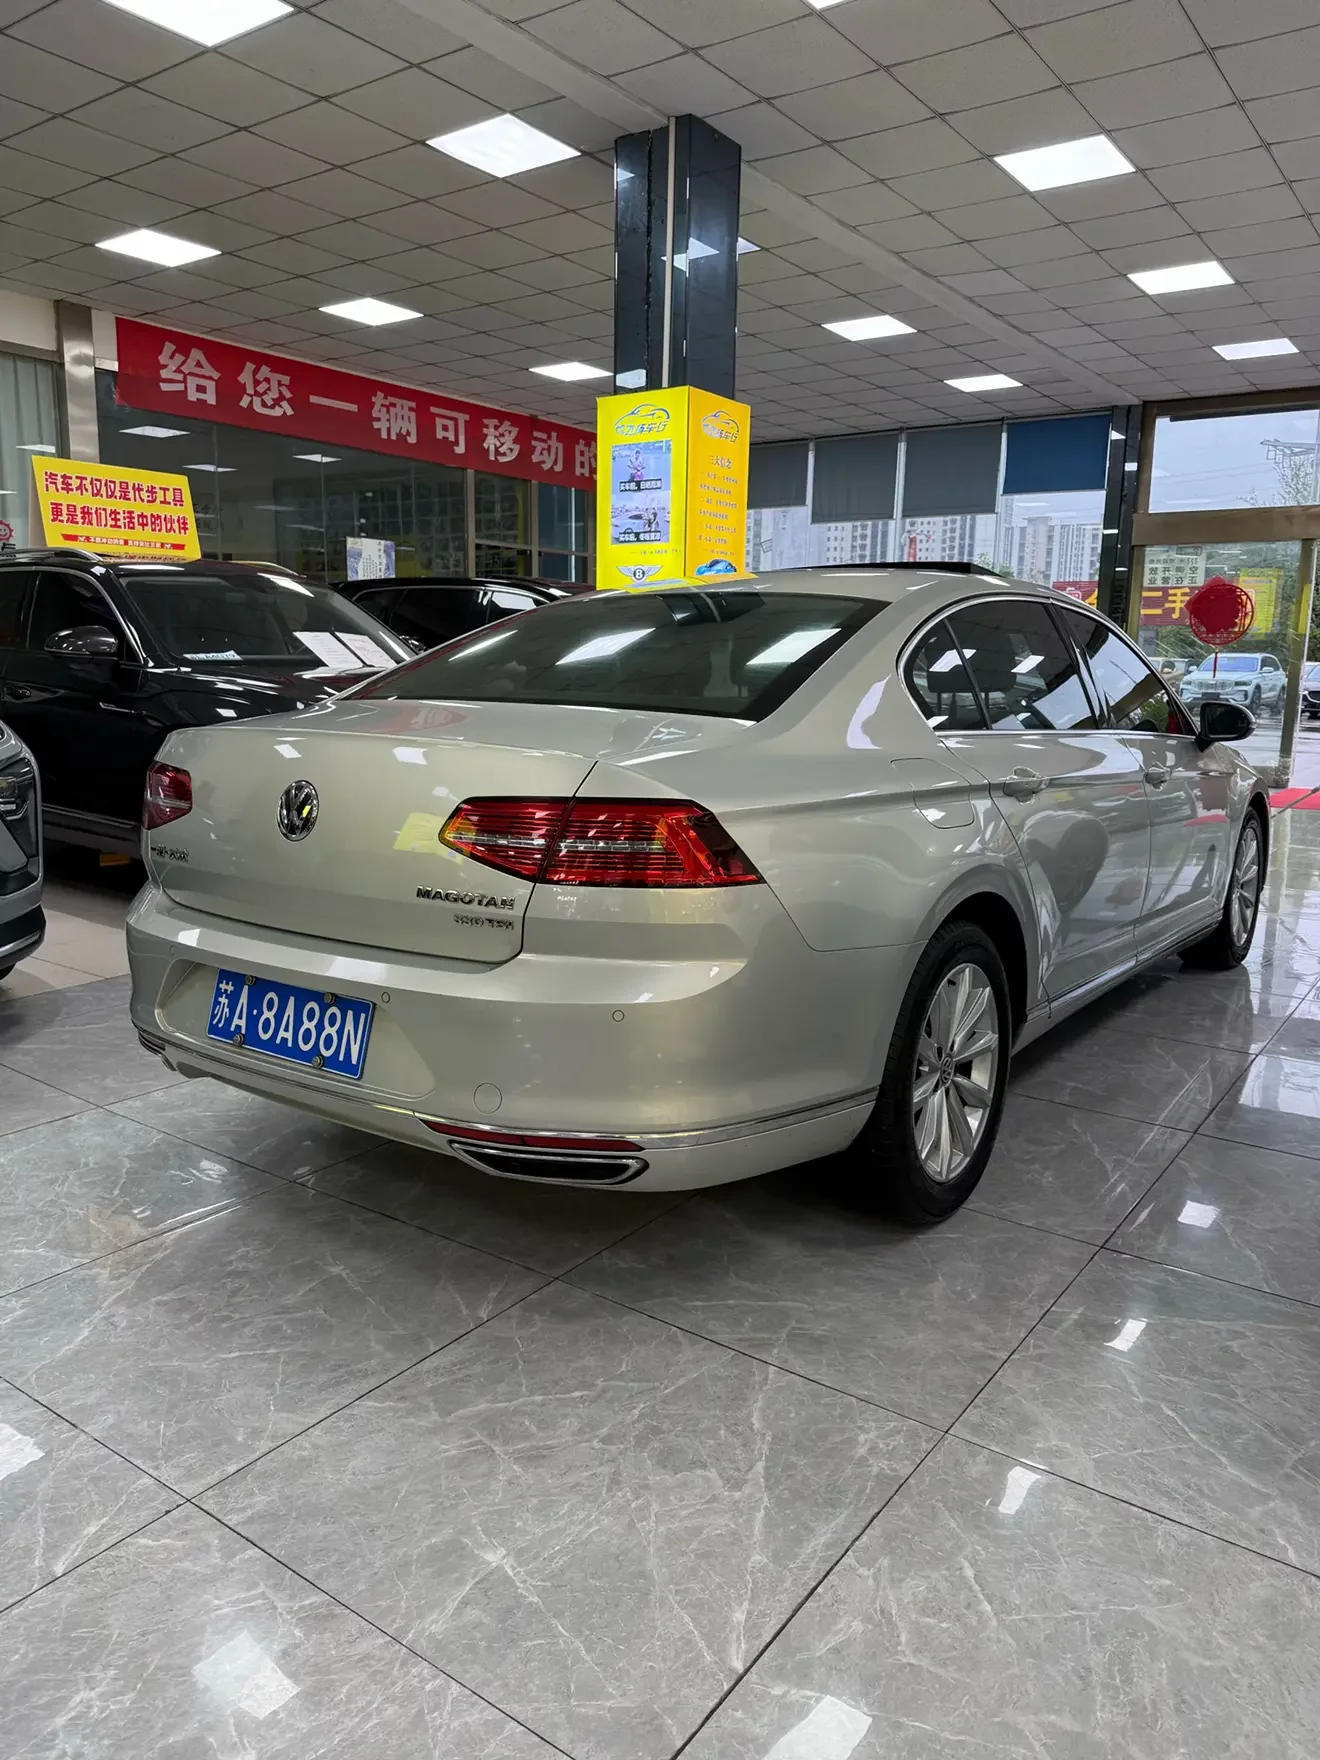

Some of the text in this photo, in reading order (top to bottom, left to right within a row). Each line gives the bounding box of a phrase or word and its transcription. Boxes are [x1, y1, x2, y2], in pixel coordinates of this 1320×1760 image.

[158, 341, 598, 479] 给您一辆可移动的
[44, 471, 185, 507] 汽车不仅仅是代步工具
[50, 502, 190, 535] 更是我们生活中的伙伴
[416, 885, 515, 910] MAGOTAN
